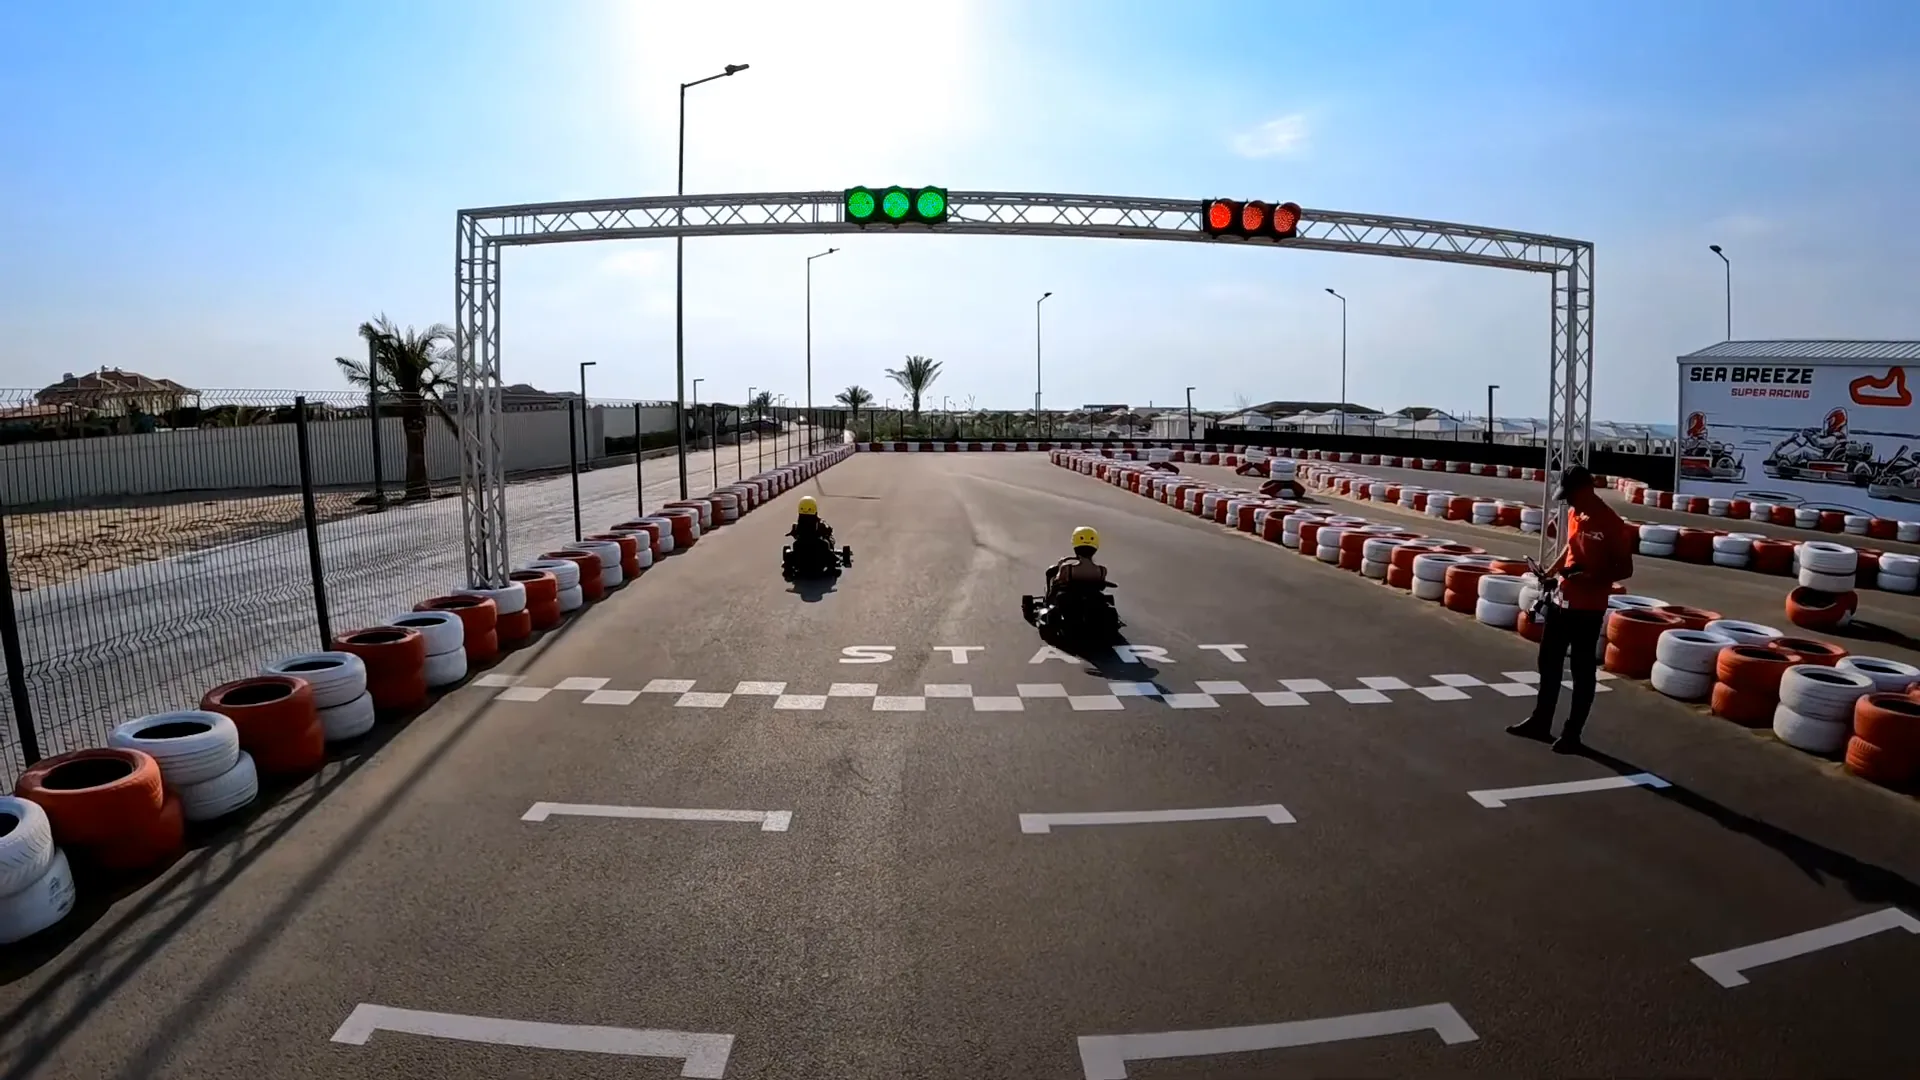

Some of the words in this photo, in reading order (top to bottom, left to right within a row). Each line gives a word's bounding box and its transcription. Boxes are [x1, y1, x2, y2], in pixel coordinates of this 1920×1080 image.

[1690, 367, 1727, 382] SEA
[1731, 367, 1814, 384] BREEZE
[1731, 388, 1767, 397] SUPER
[1769, 388, 1810, 399] RACING
